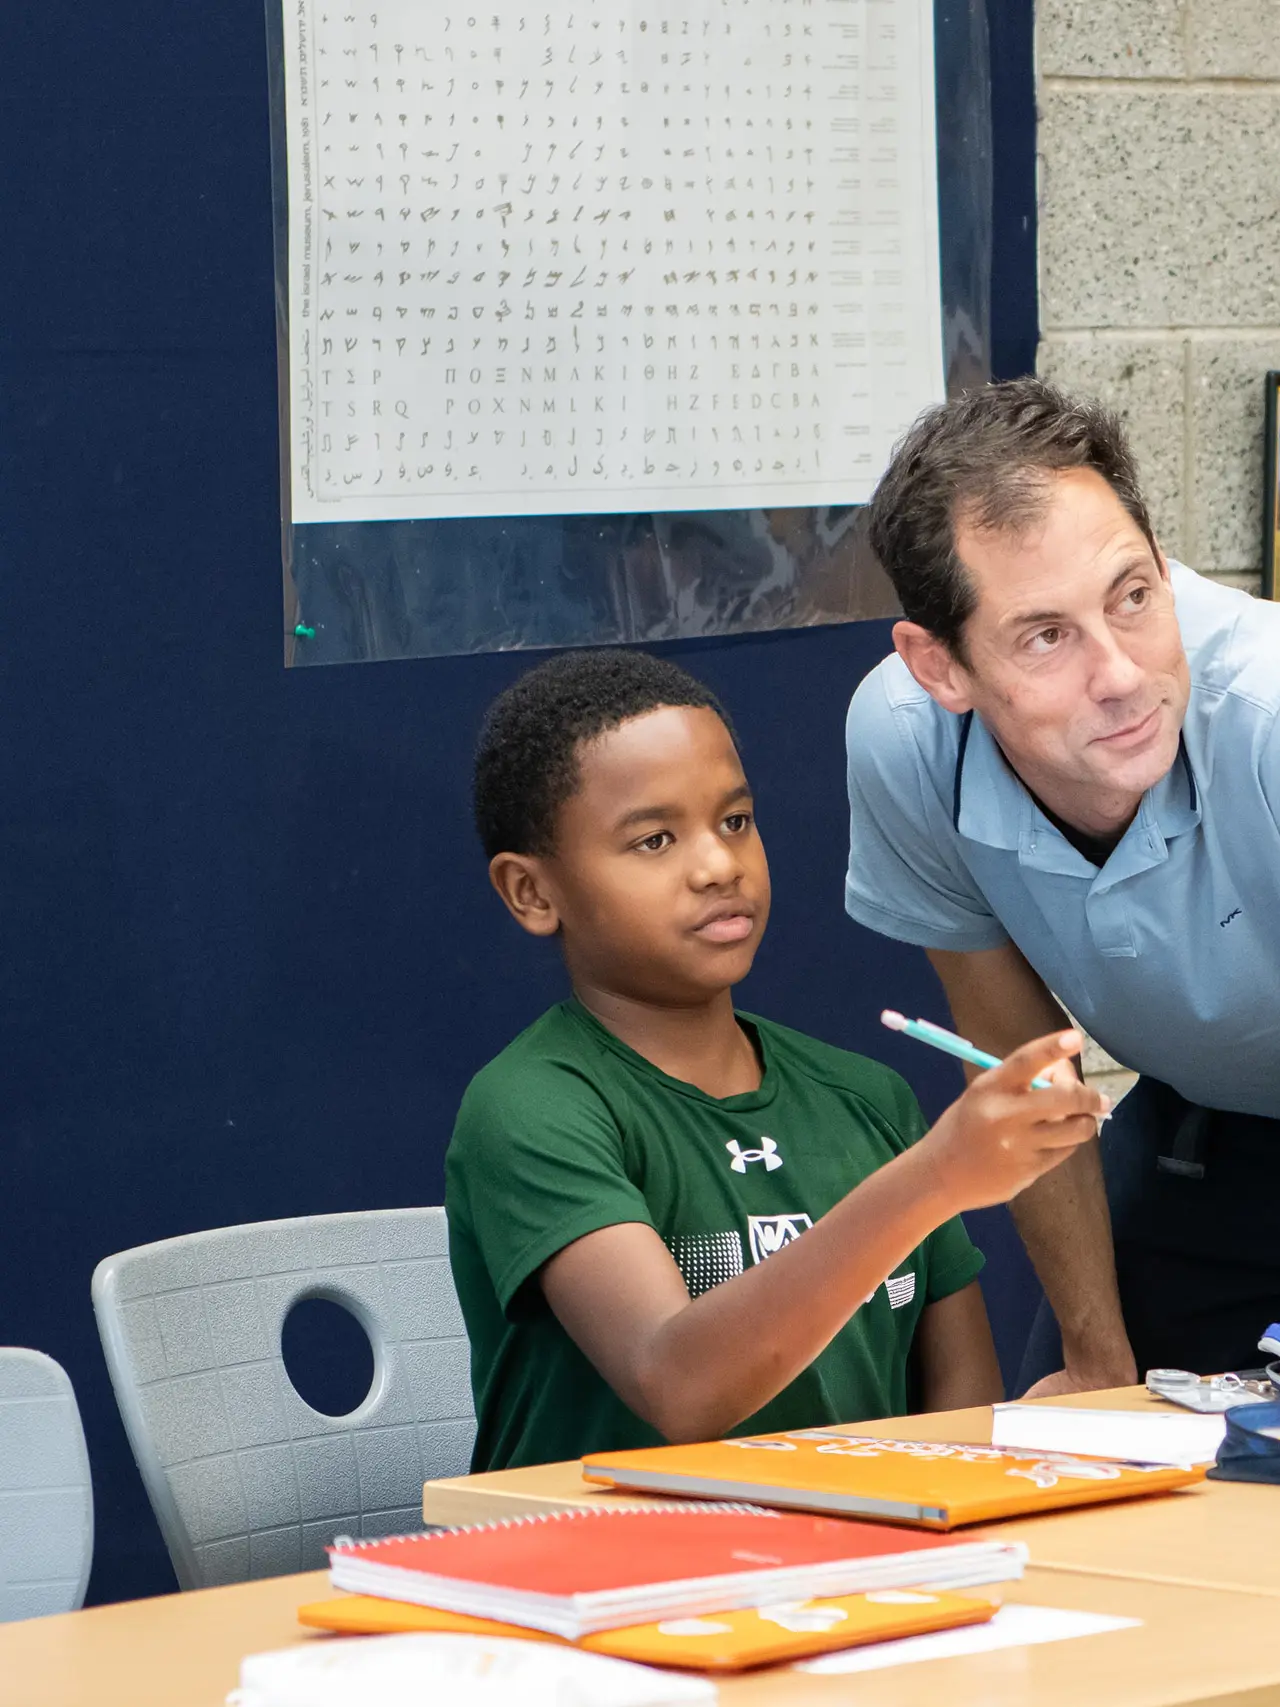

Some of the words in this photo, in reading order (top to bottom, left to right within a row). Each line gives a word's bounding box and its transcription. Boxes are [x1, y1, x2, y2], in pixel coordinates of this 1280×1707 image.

[301, 140, 313, 203] jerusalem,
[302, 205, 312, 260] museum,
[300, 264, 311, 295] israel
[301, 299, 310, 318] the
